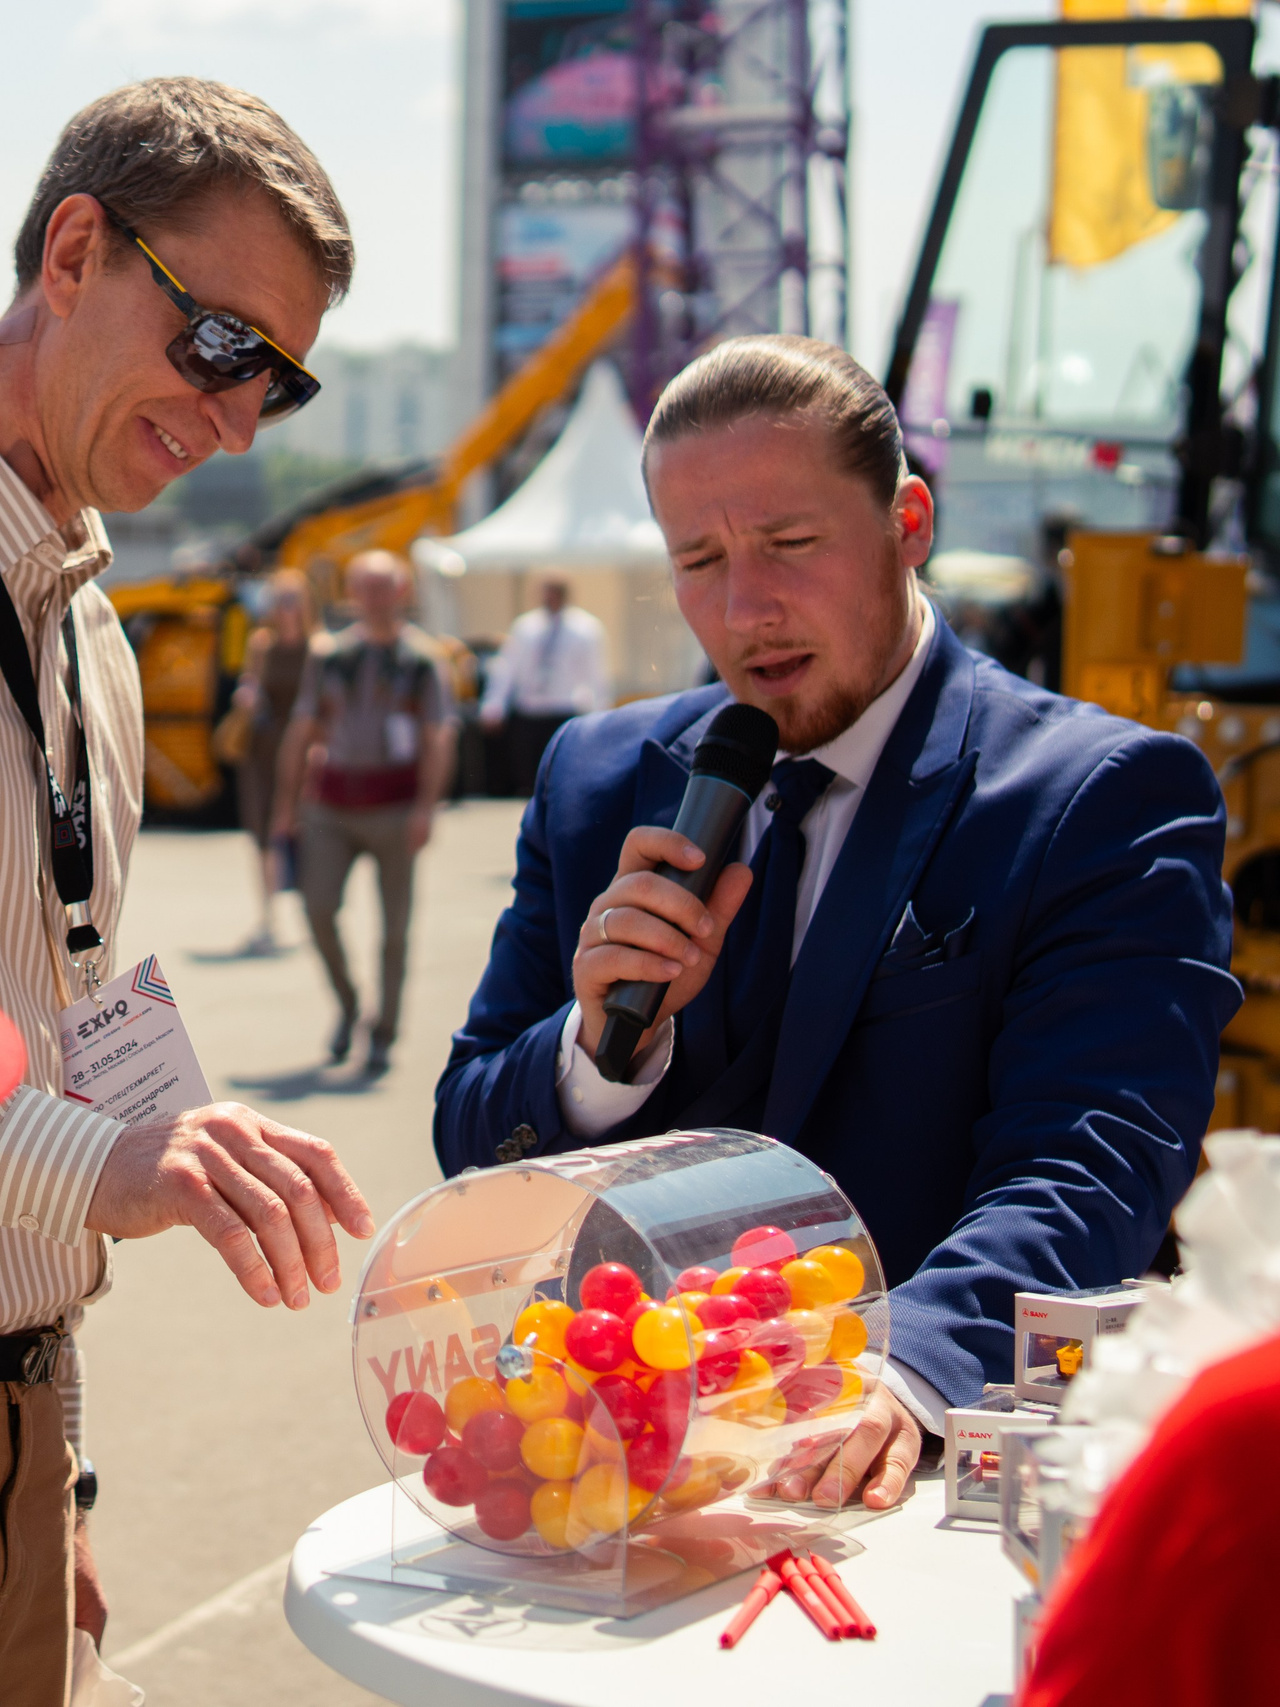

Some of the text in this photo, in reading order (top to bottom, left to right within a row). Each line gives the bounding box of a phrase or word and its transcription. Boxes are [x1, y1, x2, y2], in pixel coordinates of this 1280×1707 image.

[77, 1000, 129, 1039] EXPO
[118, 1075, 179, 1119] АЛЕКСАНДРОВИЧ
[1030, 1310, 1049, 1319] SANY
[968, 1432, 993, 1440] SANY
